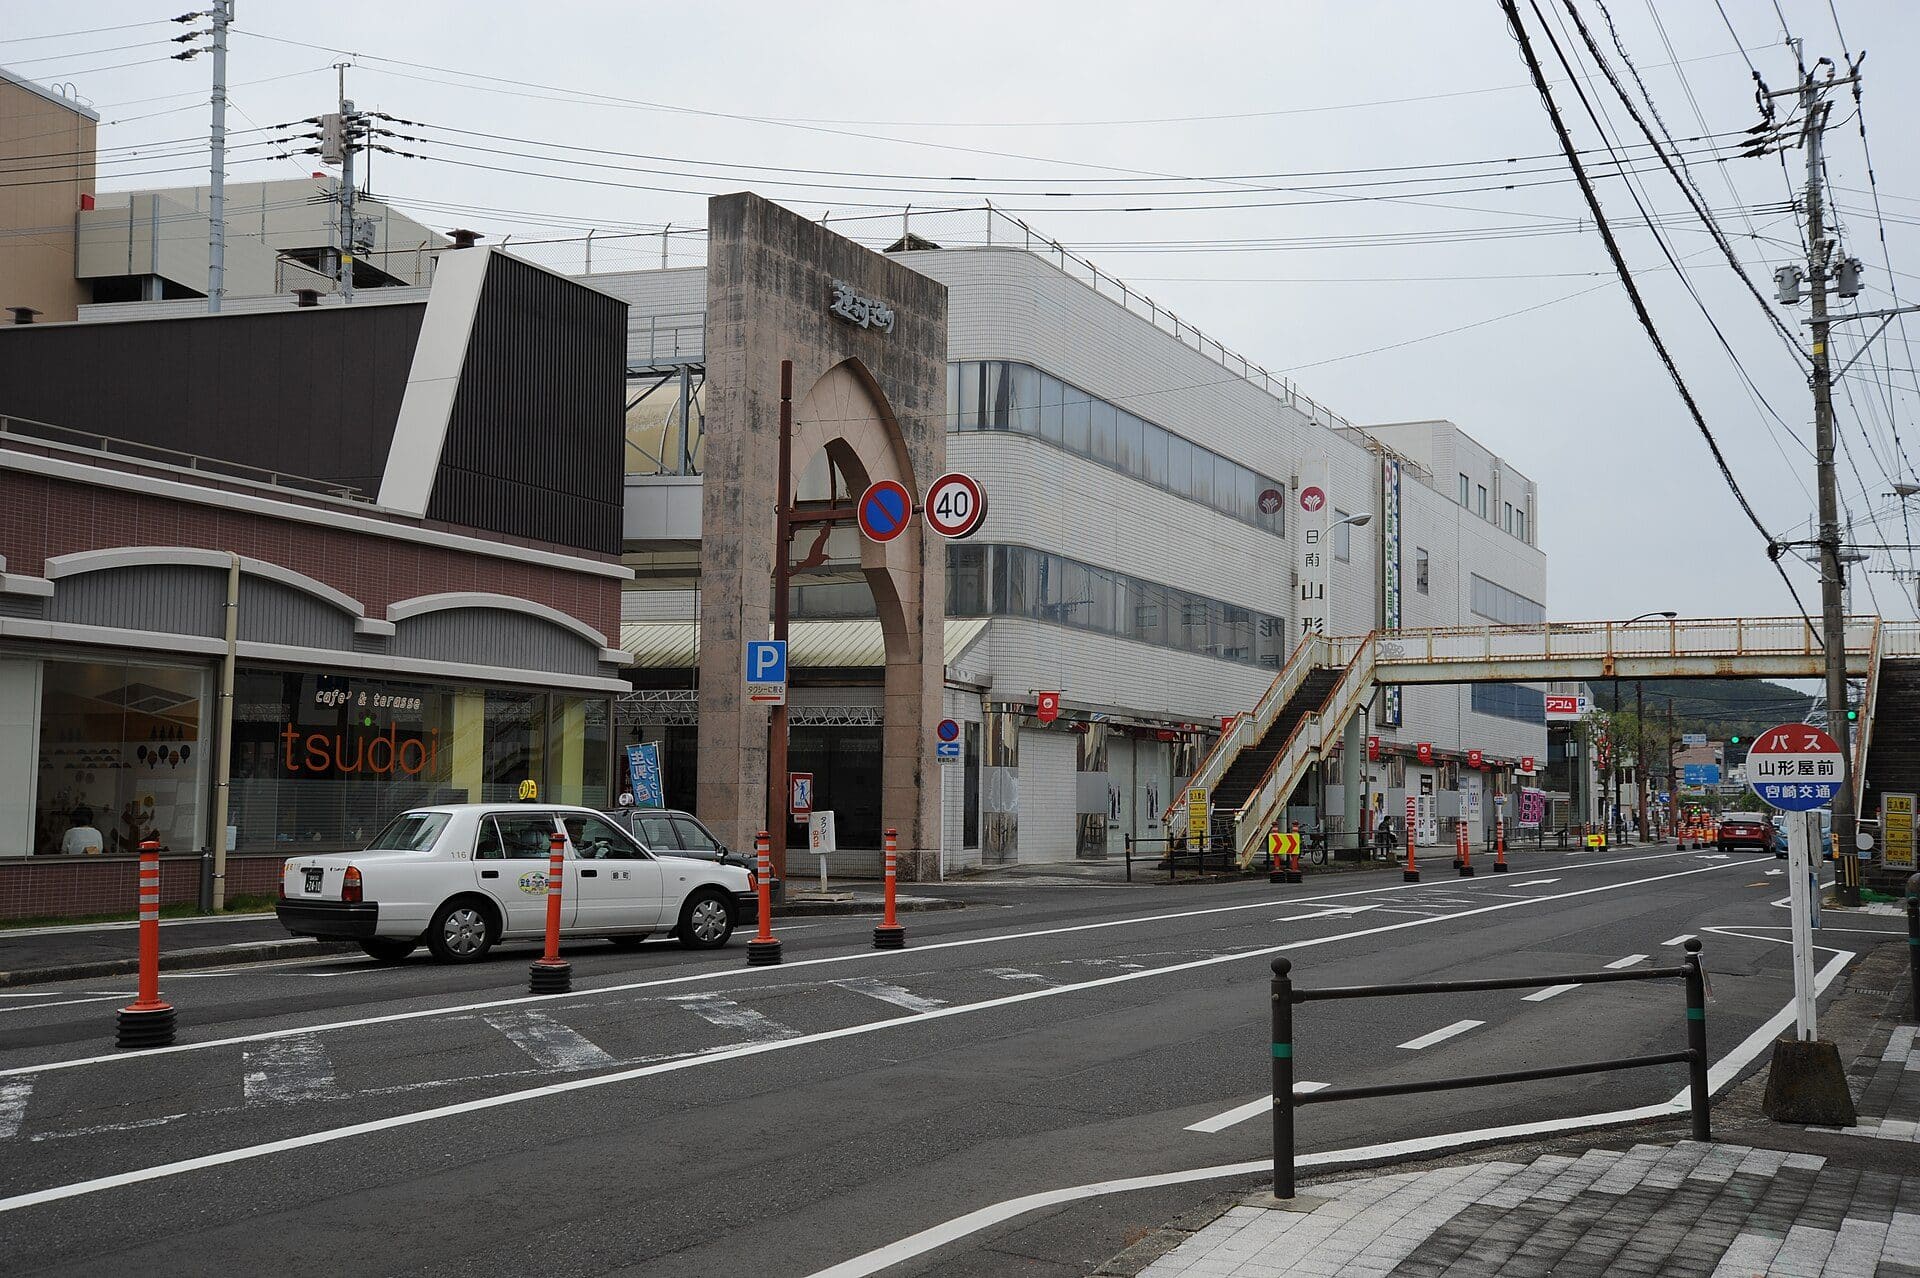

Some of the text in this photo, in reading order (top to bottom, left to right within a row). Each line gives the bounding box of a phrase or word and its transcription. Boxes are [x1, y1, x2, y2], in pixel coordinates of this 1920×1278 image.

[936, 491, 968, 519] 40
[1301, 529, 1323, 637] 日南山形
[756, 645, 779, 679] P
[747, 685, 784, 694] タクシーに限る
[357, 691, 368, 706] &
[373, 692, 421, 710] terasse
[1547, 700, 1573, 709] アコム
[281, 720, 439, 775] tsudoi
[1770, 734, 1821, 750] バス
[1758, 760, 1834, 776] 山形屋前
[1765, 784, 1831, 798] 宮崎交通
[450, 851, 466, 859] 116
